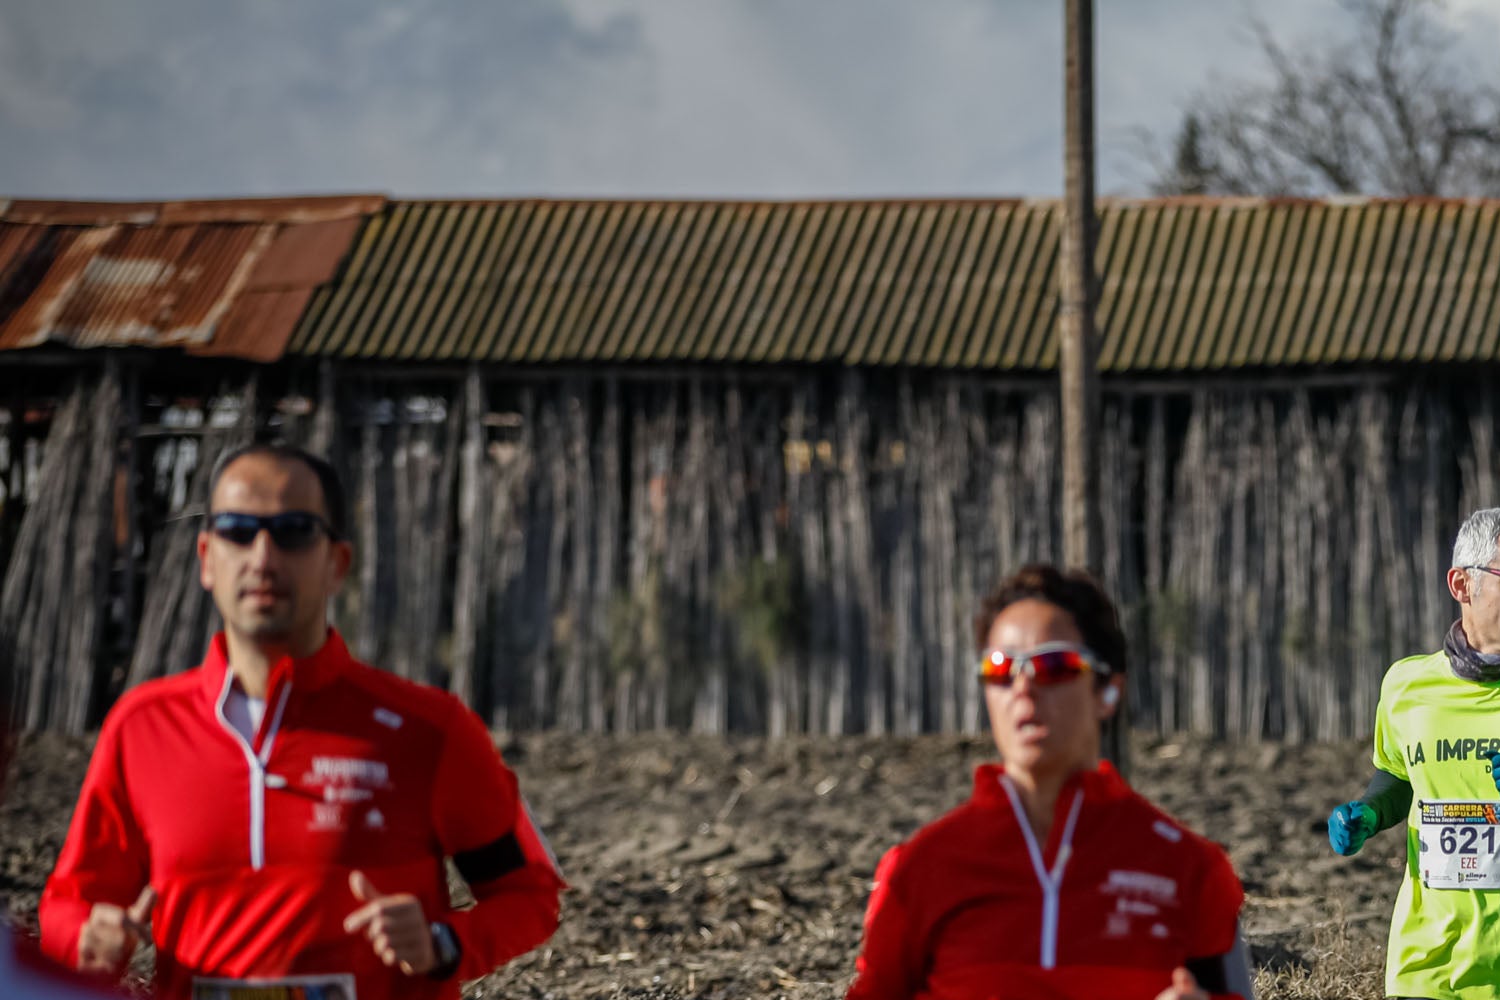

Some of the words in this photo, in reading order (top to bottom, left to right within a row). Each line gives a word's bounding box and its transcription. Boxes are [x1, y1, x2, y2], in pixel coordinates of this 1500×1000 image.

[1406, 741, 1425, 767] LA
[1439, 826, 1496, 855] 621
[1461, 857, 1478, 869] EZE
